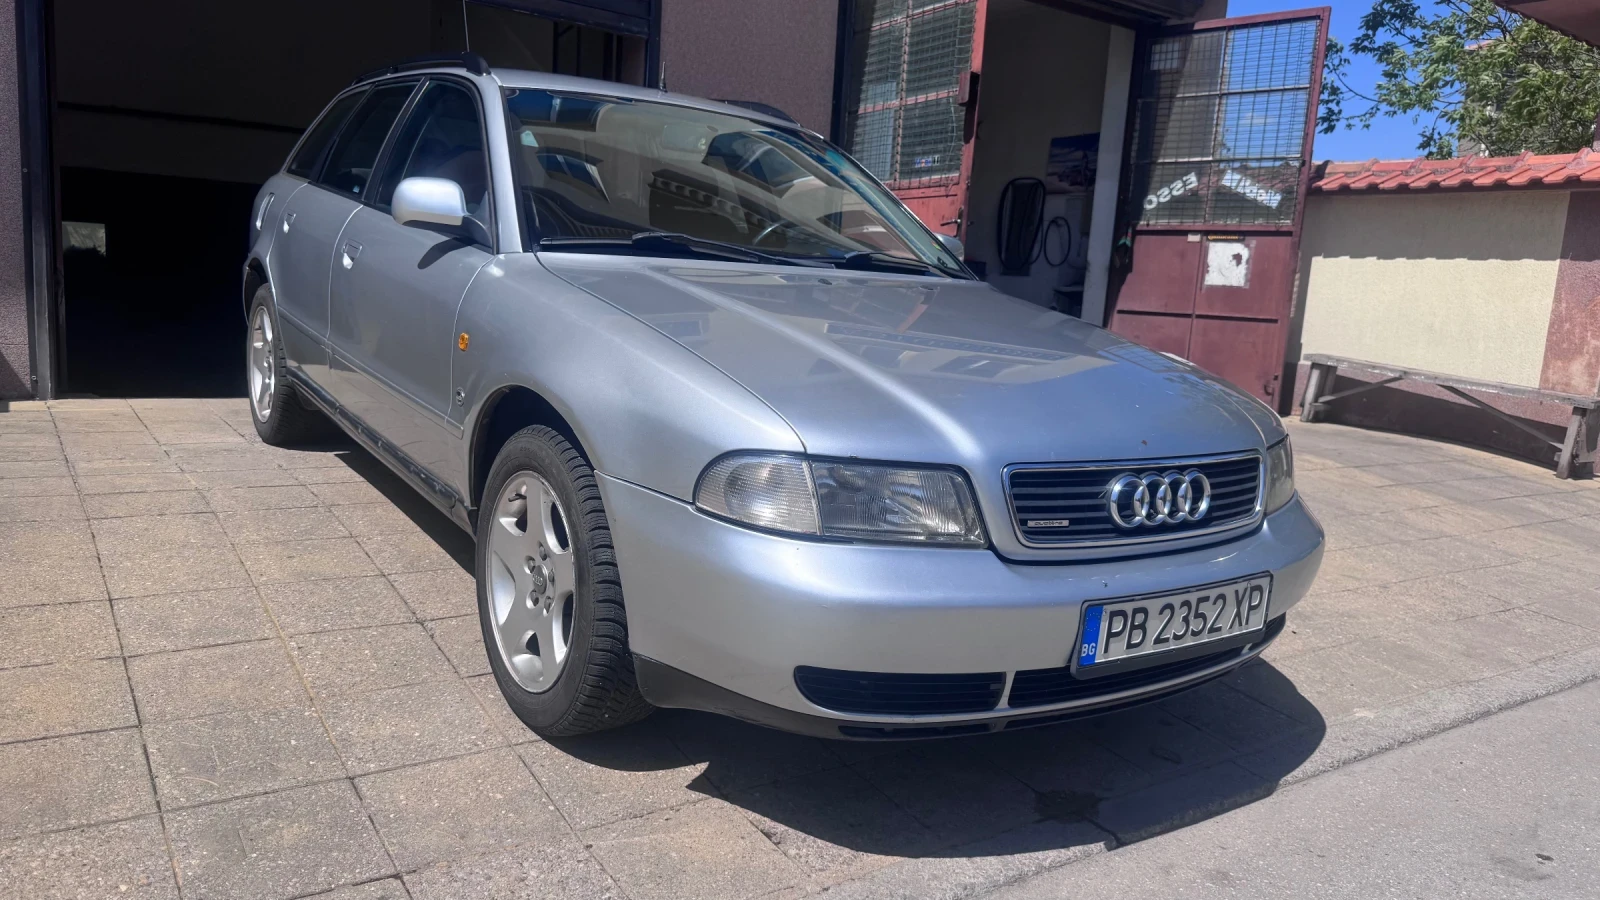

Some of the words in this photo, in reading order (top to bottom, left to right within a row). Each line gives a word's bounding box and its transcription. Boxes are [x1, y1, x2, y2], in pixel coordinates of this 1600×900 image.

[1102, 607, 1149, 654] PB
[1151, 593, 1226, 646] 2352
[1227, 584, 1264, 630] XP
[1081, 642, 1096, 657] BG
